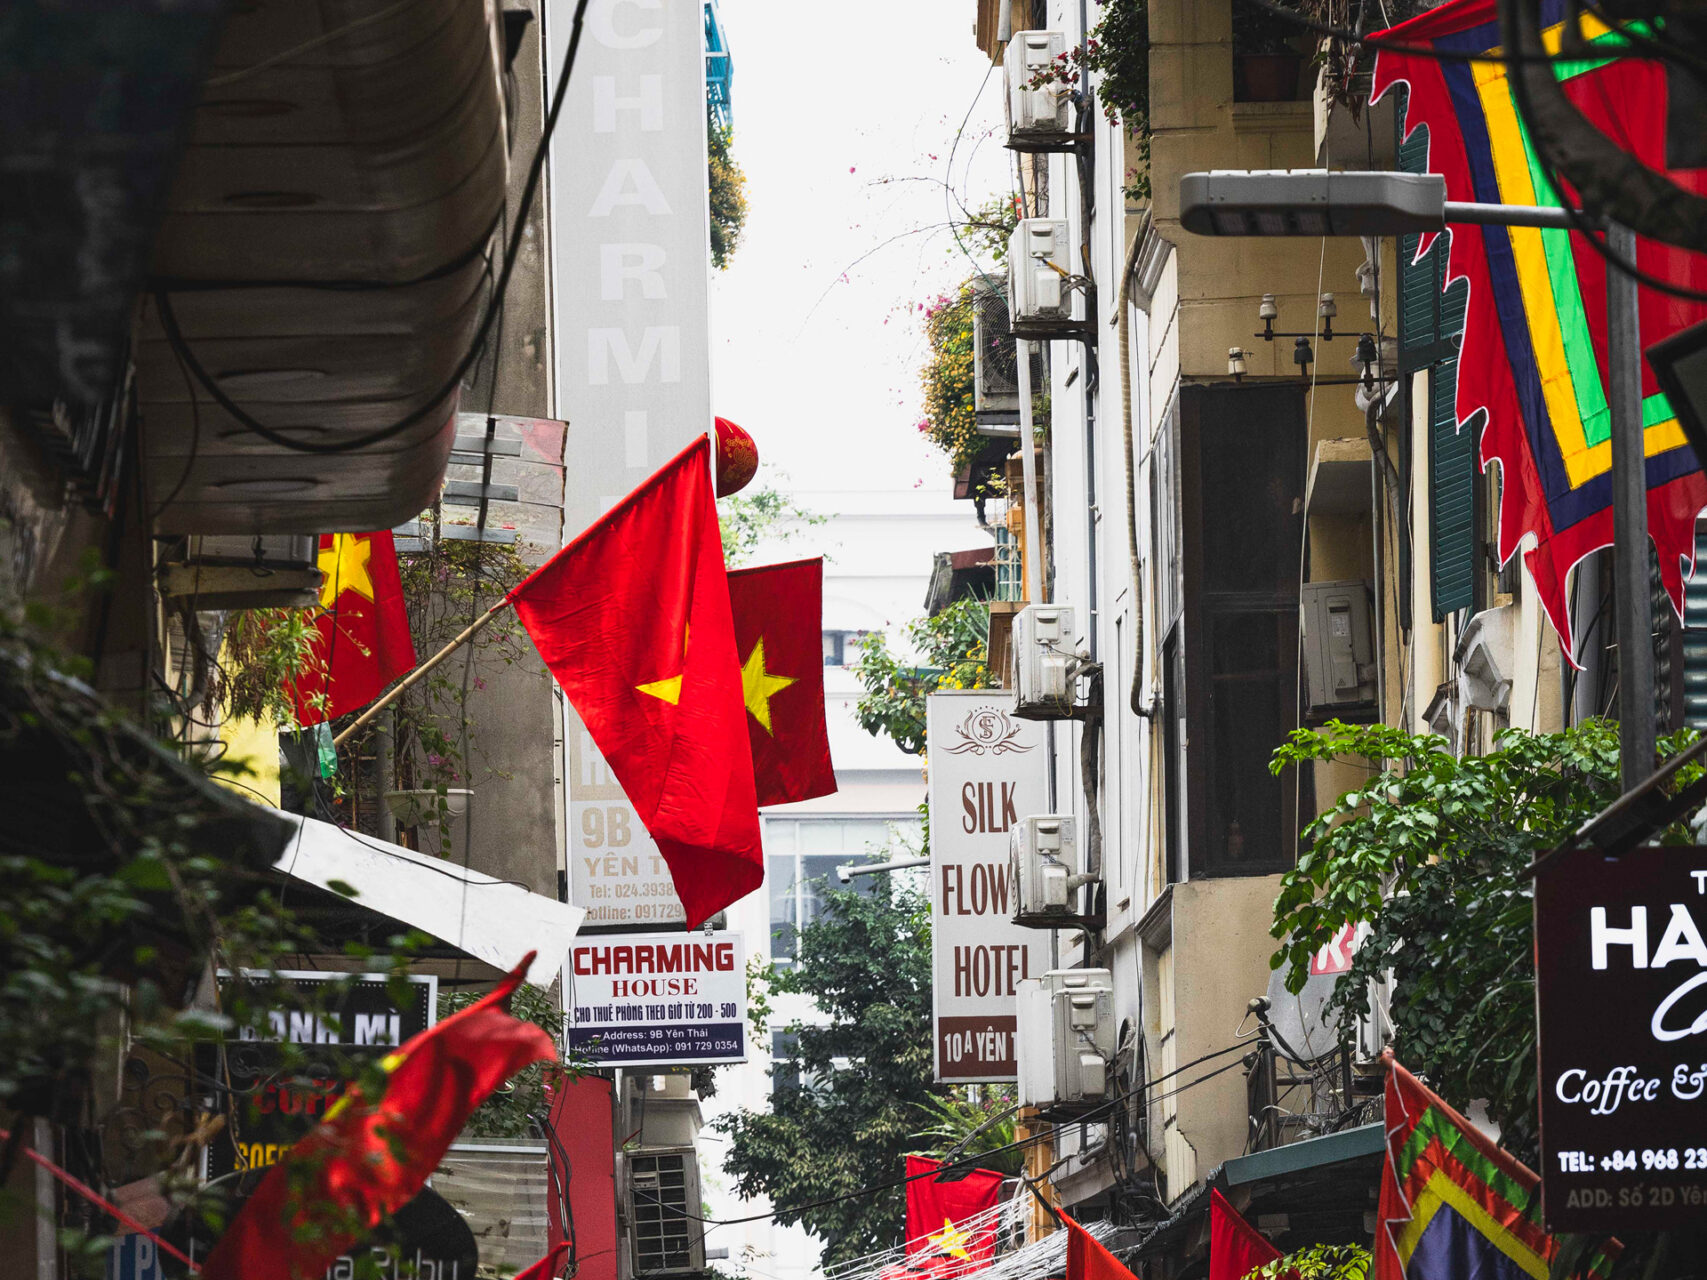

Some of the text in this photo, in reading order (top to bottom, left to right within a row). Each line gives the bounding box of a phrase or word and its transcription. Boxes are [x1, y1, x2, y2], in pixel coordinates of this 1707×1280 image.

[586, 0, 682, 499] CHARMI
[962, 780, 1017, 835] SILK
[581, 806, 632, 849] 9B
[584, 852, 671, 877] YÊN T
[615, 881, 678, 898] 024.3938
[635, 903, 686, 919] 091729
[573, 942, 734, 976] CHARMING
[611, 977, 698, 998] HOUSE
[574, 1006, 591, 1023] CHO
[593, 1003, 614, 1022] THUÊ
[615, 1002, 643, 1021] PHÒNG
[645, 1005, 666, 1021] THEO
[668, 1001, 684, 1020] GIỜ
[696, 1003, 713, 1019] 200
[720, 1002, 737, 1018] 500
[602, 1027, 709, 1041] Address: 9B Yên Thái
[975, 1025, 1007, 1062] YÊN
[611, 1042, 673, 1055] (WhatsApp):
[675, 1041, 692, 1051] 091
[695, 1040, 712, 1050] 729
[714, 1039, 738, 1050] 0354
[1555, 1064, 1661, 1115] Coffee
[1557, 1150, 1595, 1173] TEL:
[1600, 1150, 1638, 1172] +84
[1641, 1149, 1679, 1171] 968
[1566, 1188, 1612, 1209] ADD:
[1618, 1182, 1645, 1207] Số
[1649, 1186, 1675, 1206] 2D
